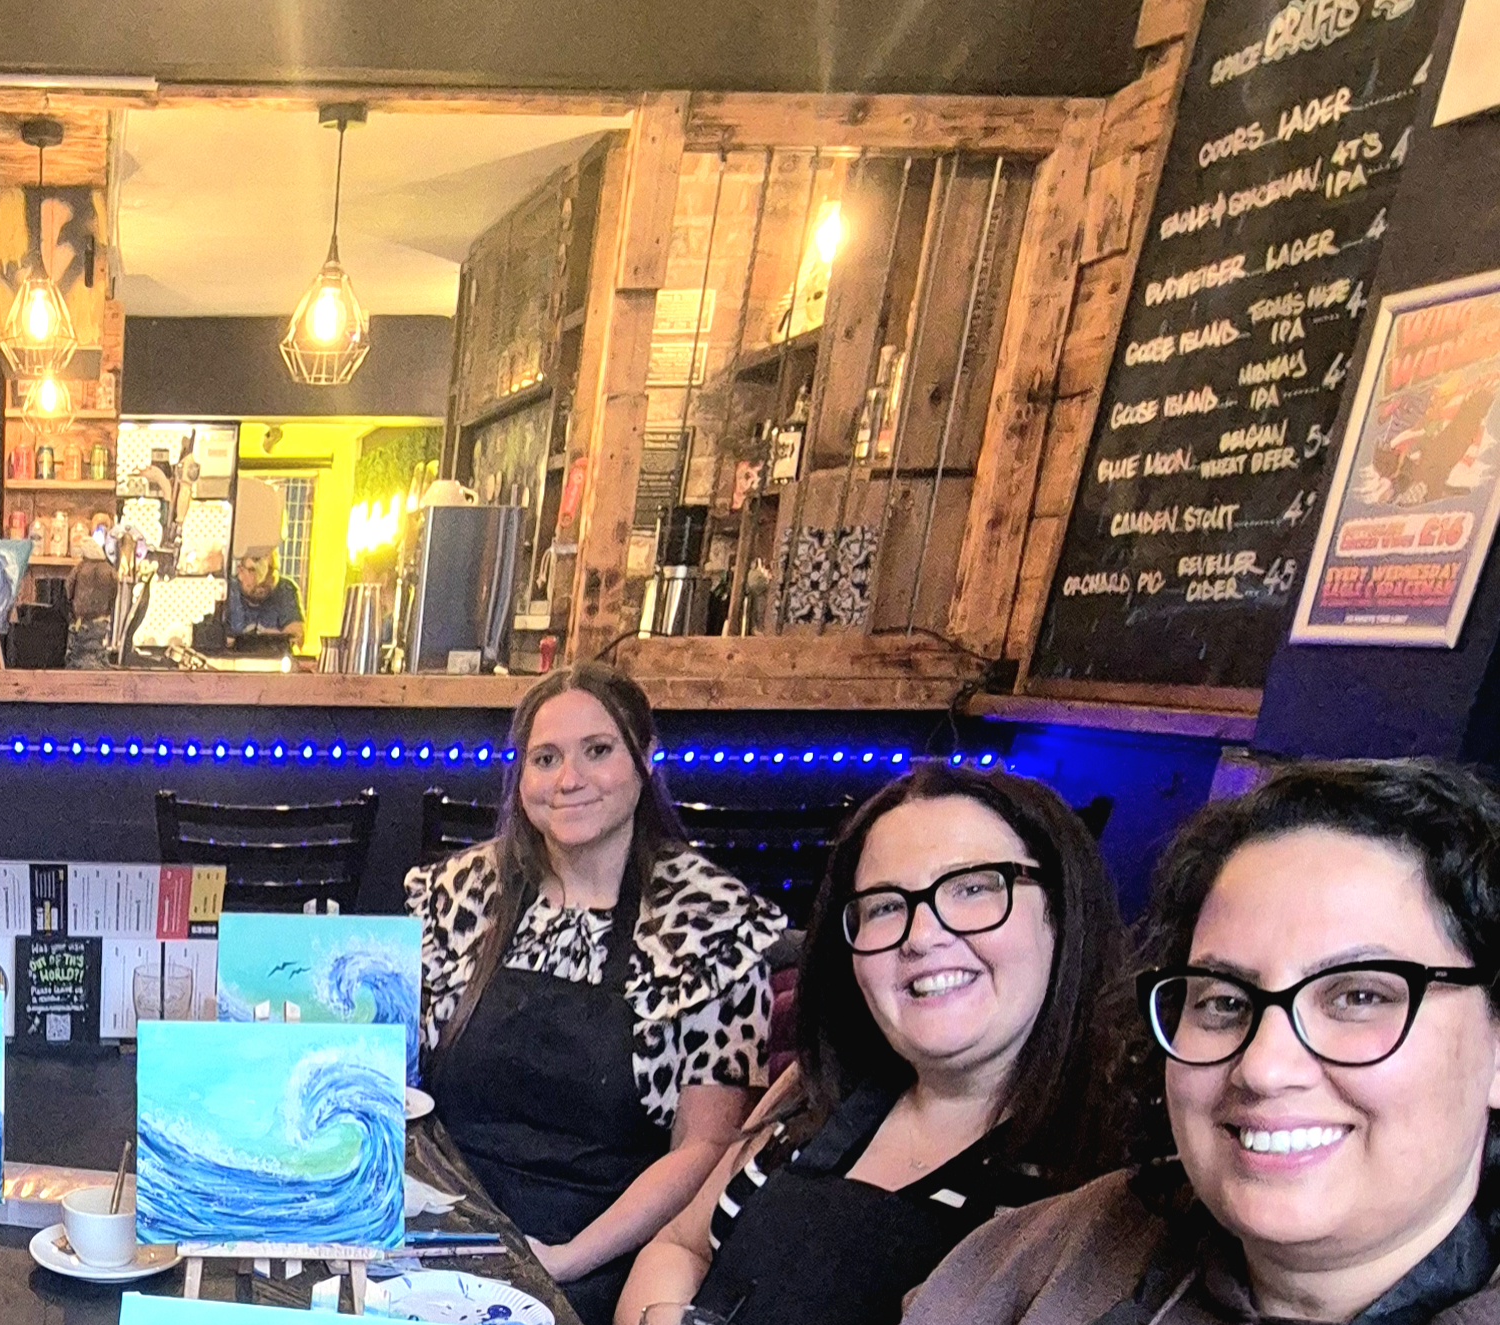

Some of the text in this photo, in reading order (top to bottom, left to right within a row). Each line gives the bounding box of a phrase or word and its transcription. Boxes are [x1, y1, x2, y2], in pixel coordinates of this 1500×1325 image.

[1199, 122, 1266, 168] COORS
[1277, 86, 1353, 140] LAGER
[1325, 163, 1368, 199] IPA
[1145, 254, 1247, 307] BUDWEISER
[1266, 228, 1340, 272] LAGER
[1124, 316, 1305, 367] GOOSE ISLAND IPA
[1110, 400, 1159, 430] GOOSE
[1163, 384, 1219, 417] ISLAND
[1250, 383, 1280, 411] IPA
[1097, 445, 1298, 484] BLUE MOON WHEAT BEER
[1110, 504, 1179, 538] CAMDEN
[1182, 502, 1241, 532] STOUT
[1177, 550, 1266, 578] REVELLER
[1062, 571, 1131, 597] ORCHARD
[1186, 577, 1245, 603] CIDER
